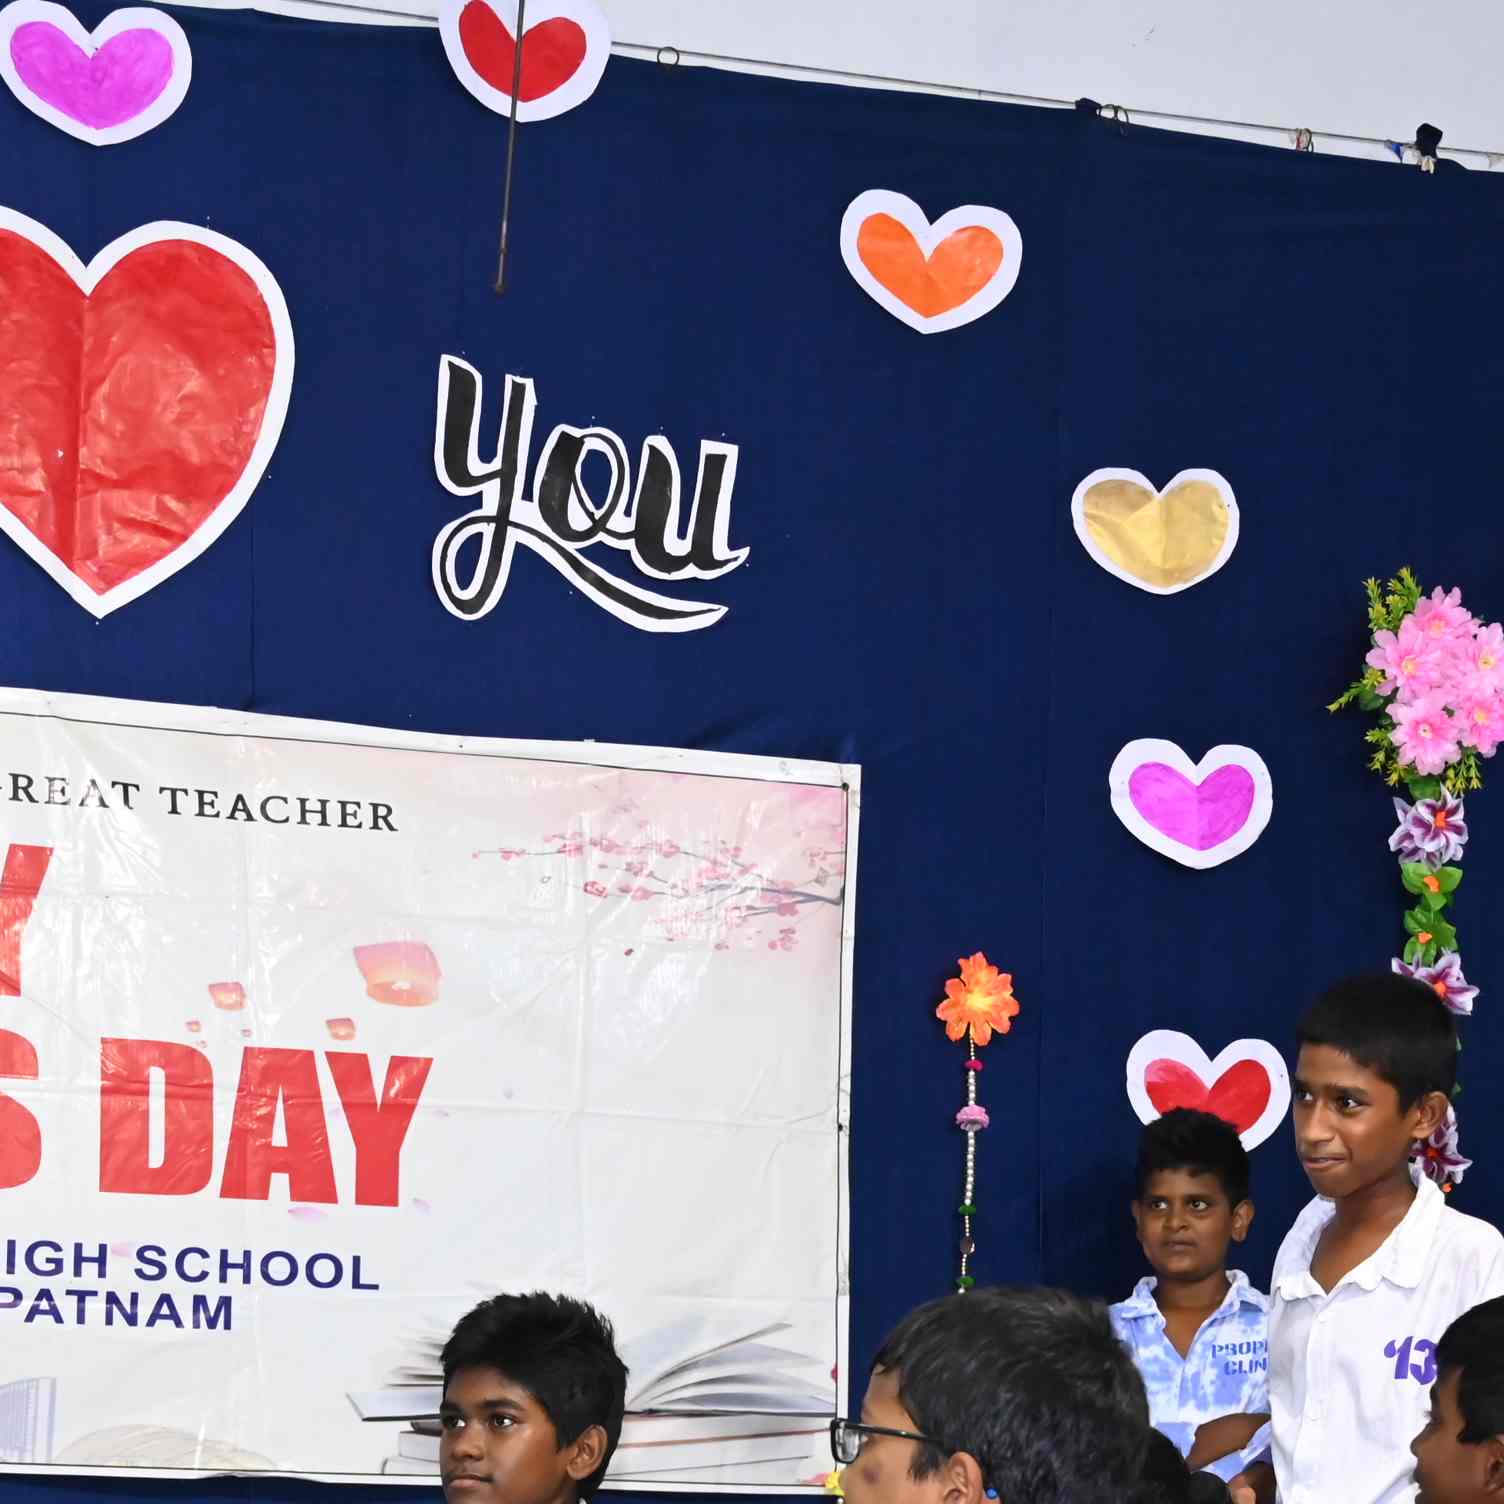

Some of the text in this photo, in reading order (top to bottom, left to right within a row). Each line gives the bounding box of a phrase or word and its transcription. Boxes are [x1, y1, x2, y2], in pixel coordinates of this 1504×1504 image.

[159, 786, 399, 833] TEACHER
[99, 1037, 434, 1208] DAY
[134, 1243, 380, 1291] SCHOOL
